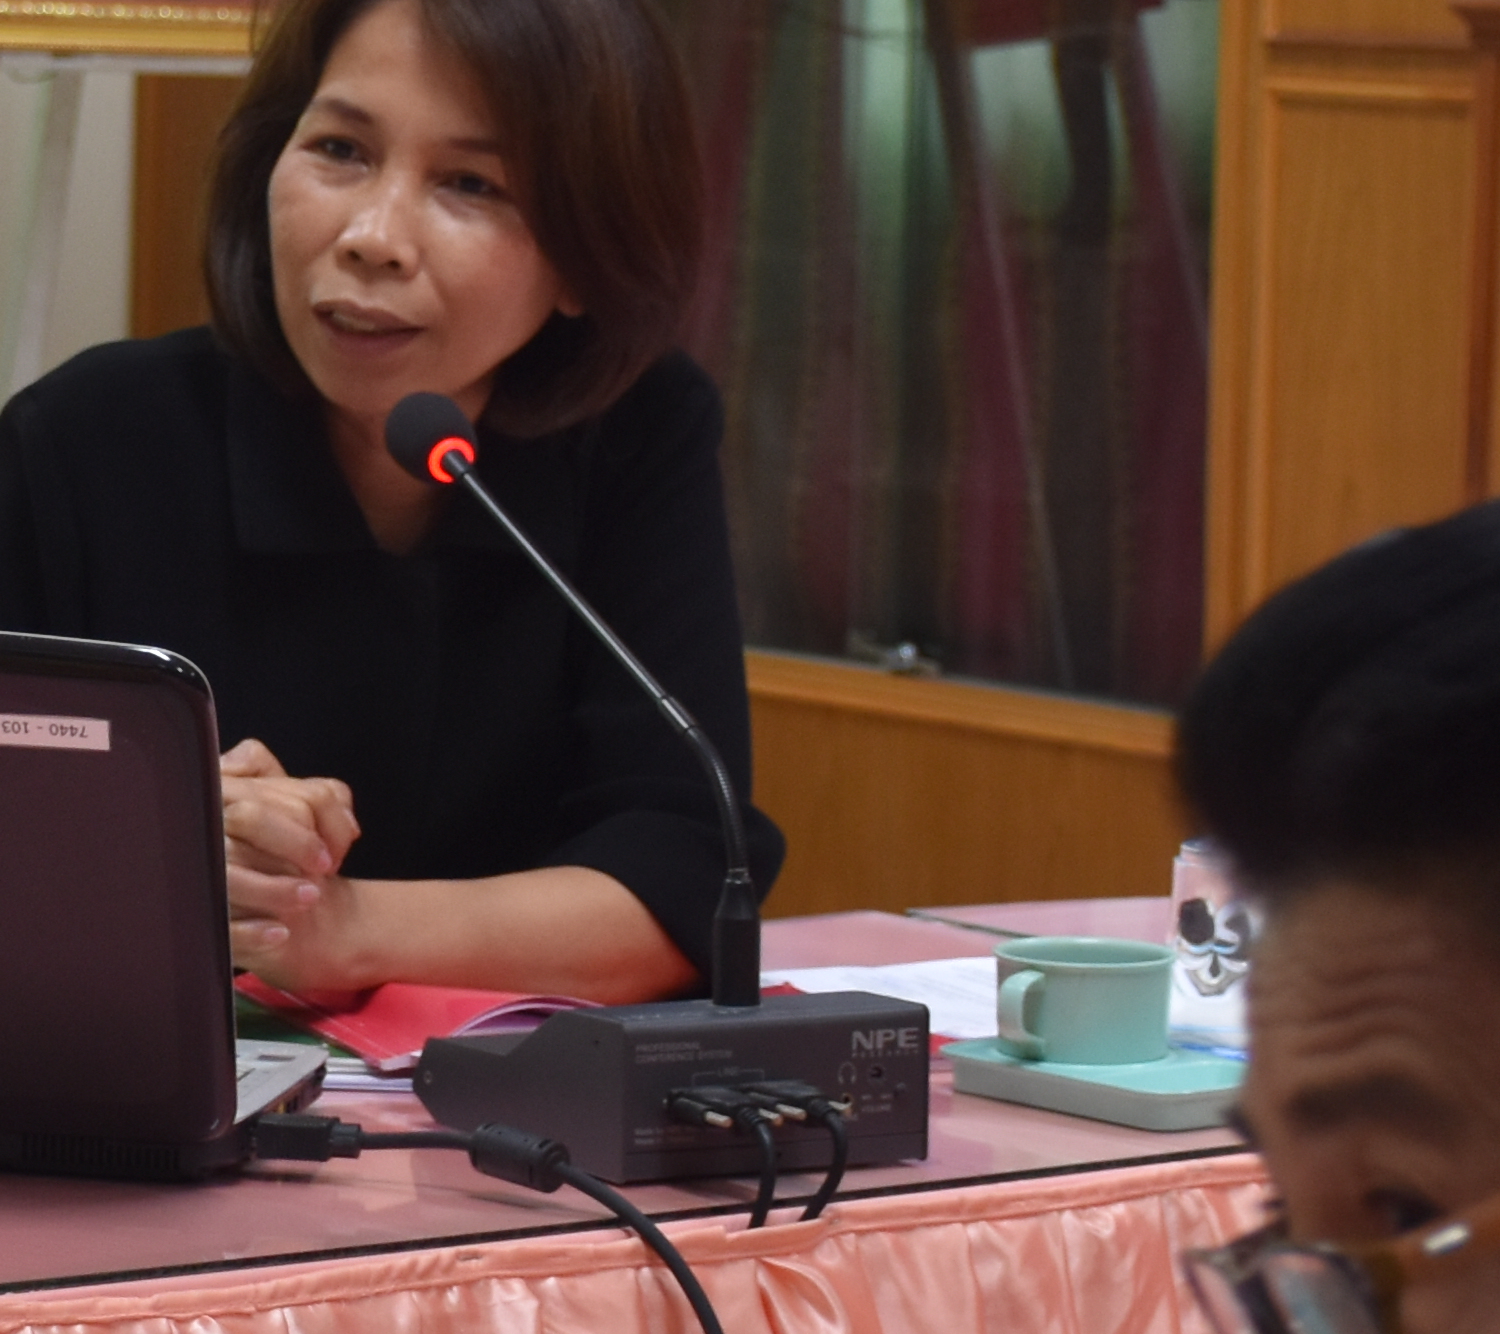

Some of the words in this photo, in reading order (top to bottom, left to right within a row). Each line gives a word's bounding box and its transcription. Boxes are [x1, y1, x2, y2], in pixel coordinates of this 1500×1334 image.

[2, 719, 30, 735] 103
[49, 722, 89, 739] 7440
[851, 1027, 920, 1051] NPE
